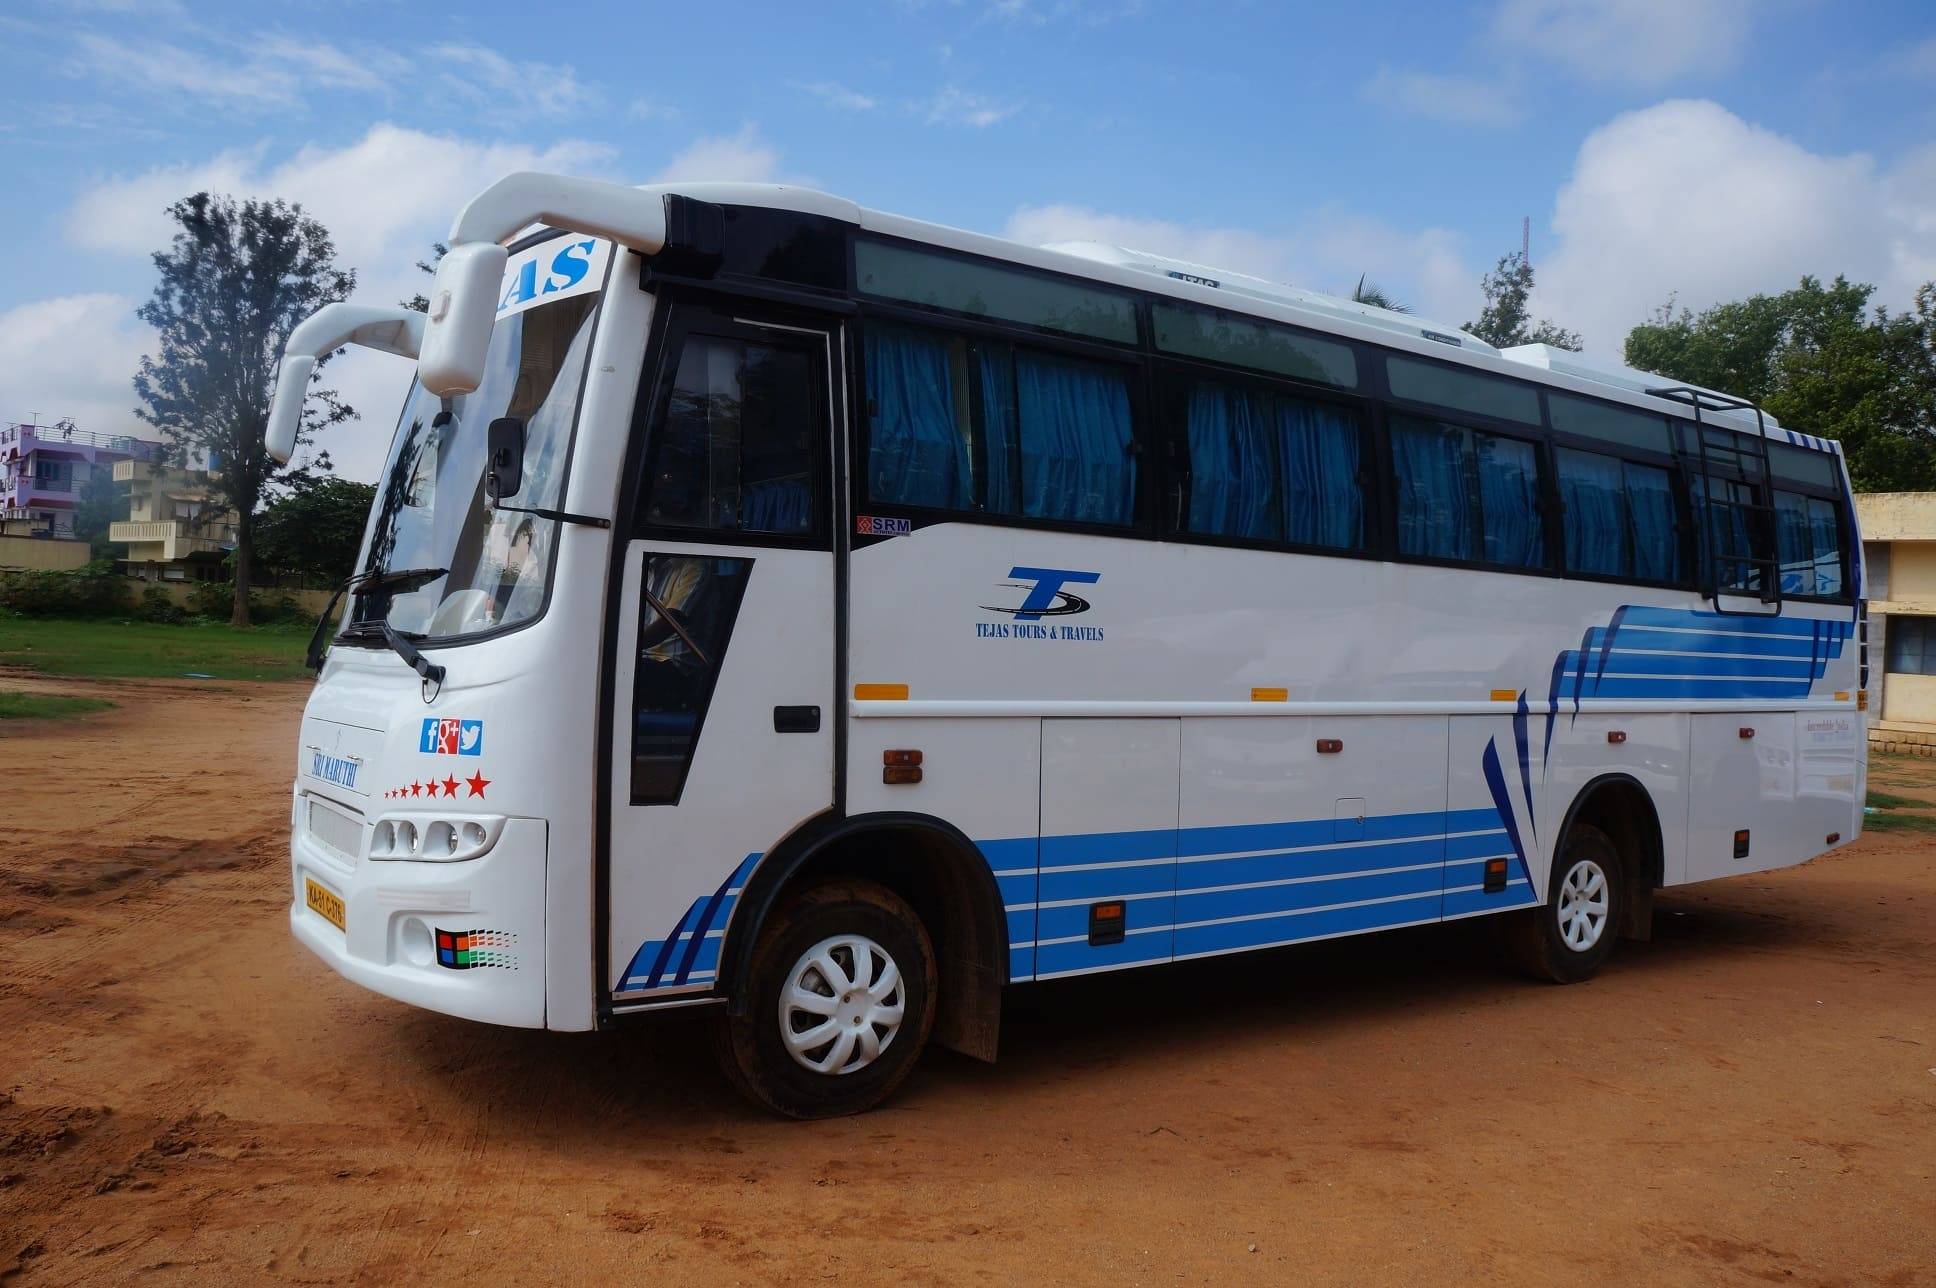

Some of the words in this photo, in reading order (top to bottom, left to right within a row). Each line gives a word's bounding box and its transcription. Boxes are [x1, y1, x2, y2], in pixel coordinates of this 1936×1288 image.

[873, 519, 909, 532] SRM
[976, 623, 1009, 638] TEJAS
[1013, 624, 1047, 639] TOURS
[1050, 626, 1057, 640] &
[1061, 626, 1104, 641] TRAVELS
[323, 756, 358, 788] MARUTHI
